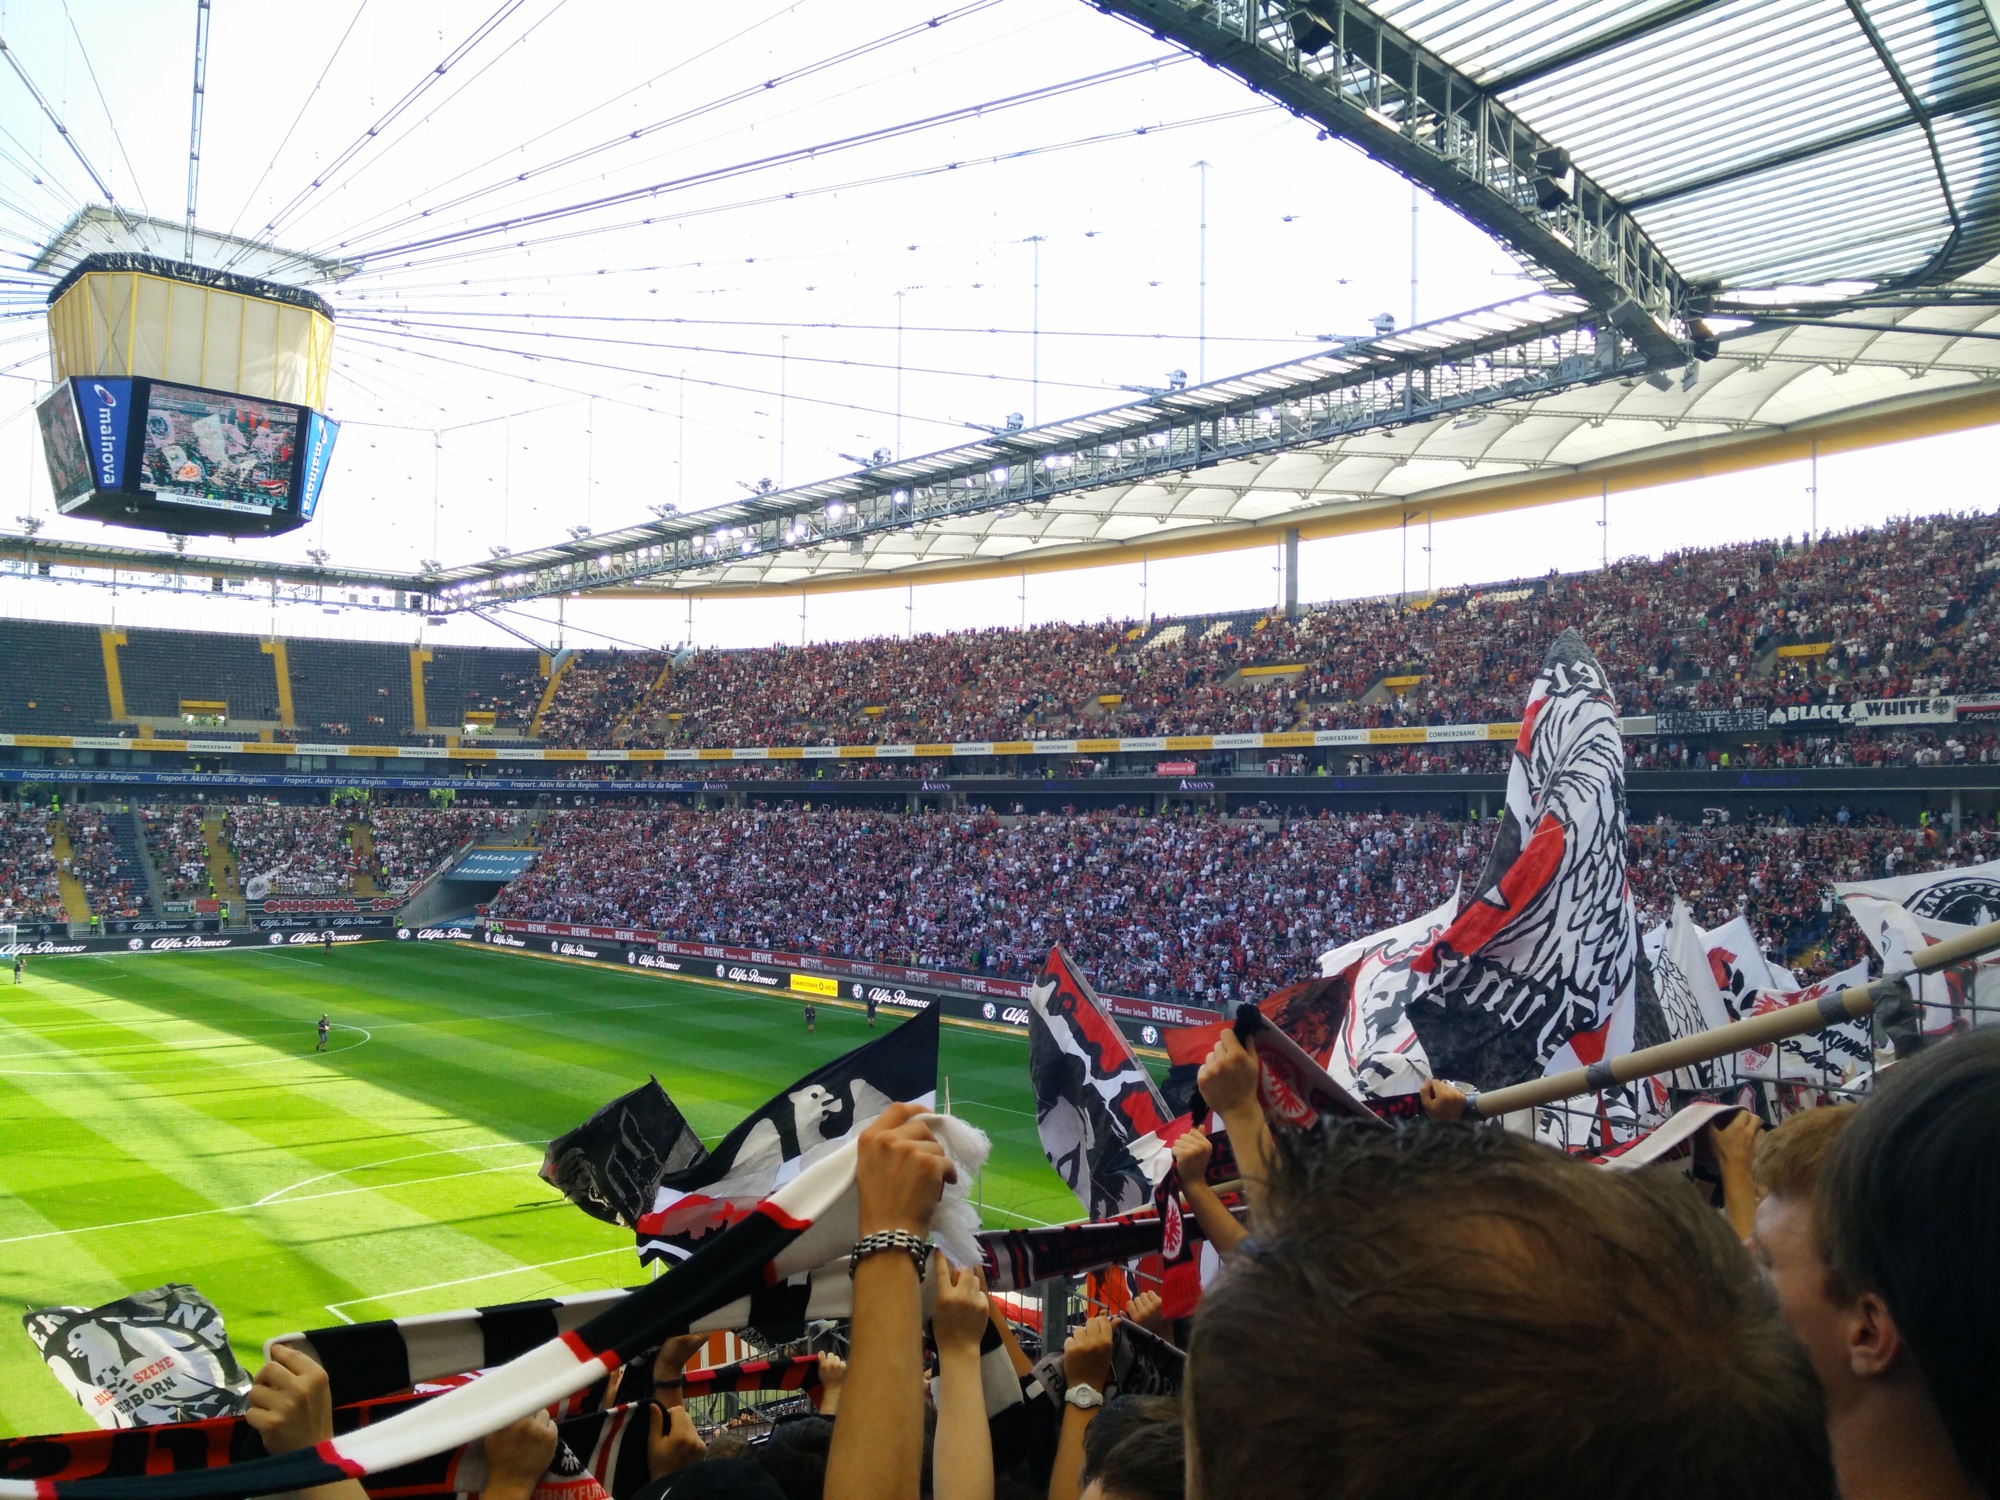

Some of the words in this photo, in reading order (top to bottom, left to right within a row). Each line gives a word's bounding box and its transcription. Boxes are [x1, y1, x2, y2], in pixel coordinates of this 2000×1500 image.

[99, 407, 116, 484] mainova
[303, 441, 322, 510] mainova
[176, 497, 222, 508] COMMERZBANK
[232, 504, 253, 512] ARENA
[1788, 705, 1845, 721] BLACK
[1865, 700, 1930, 717] WHITE
[1316, 734, 1359, 742] COMMERZBANK
[1428, 730, 1476, 738] COMMERZBANK
[1214, 738, 1254, 746] COMMERZBANK
[23, 772, 56, 780] Fraport.
[110, 773, 141, 781] Region.
[157, 774, 188, 782] Fraport.
[239, 776, 268, 784] Region.
[283, 777, 313, 785] Fraport.
[402, 780, 430, 788] Fraport.
[702, 781, 728, 790] ANSON'S
[921, 781, 951, 790] ANSON'S
[1179, 779, 1215, 789] ANSON'S
[263, 899, 360, 913] ORIGINAL
[133, 922, 156, 933] Alfa
[155, 921, 187, 930] Romeo
[261, 919, 283, 928] Alfa
[282, 918, 311, 927] Romeo
[333, 918, 355, 927] Alfa
[353, 917, 382, 926] Romeo
[528, 923, 547, 934] REWE
[290, 932, 321, 944] Alfa
[319, 930, 362, 942] Romeo
[417, 928, 445, 940] Alfa
[443, 927, 473, 940] Romeo
[571, 927, 591, 938] REWE
[615, 931, 635, 942] REWE
[32, 941, 86, 954] Romeo
[151, 937, 186, 950] Alfa
[184, 935, 231, 948] Romeo
[493, 934, 507, 946] Alfa
[504, 934, 526, 948] Romeo
[658, 941, 678, 953] REWE
[560, 943, 575, 956] Alfa
[574, 944, 598, 958] Romeo
[704, 946, 725, 959] REWE
[638, 954, 656, 968] Alfa
[655, 955, 681, 971] Romeo
[751, 951, 773, 964] REWE
[800, 957, 823, 970] REWE
[729, 967, 748, 982] Alfa
[746, 968, 779, 986] Romeo
[851, 963, 875, 977] REWE
[905, 970, 929, 984] REWE
[961, 978, 987, 993] REWE
[988, 985, 1004, 995] Besser
[1004, 988, 1019, 997] leben.
[868, 987, 893, 1004] Alfa
[890, 989, 931, 1009] Romeo
[1115, 1006, 1133, 1015] Besser
[1133, 1008, 1149, 1018] leben.
[1151, 1005, 1183, 1023] REWE
[1185, 1016, 1204, 1026] Besser
[133, 1356, 175, 1385] SZENE
